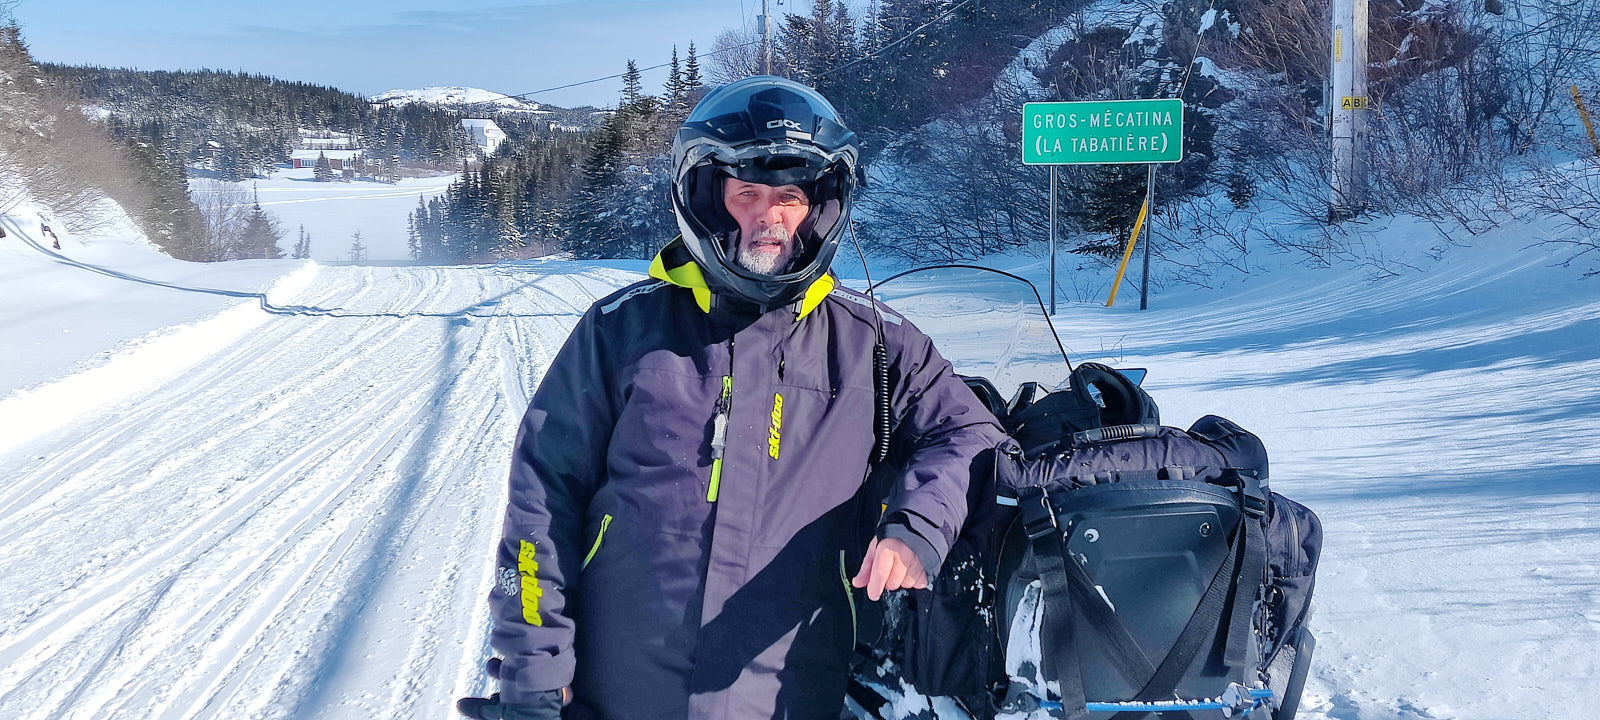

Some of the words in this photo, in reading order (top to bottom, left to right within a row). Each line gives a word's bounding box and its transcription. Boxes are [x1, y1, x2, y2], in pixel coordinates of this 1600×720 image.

[1033, 109, 1173, 129] GROS-MÉCATINA
[1035, 135, 1063, 156] (LA
[1071, 132, 1169, 154] TABATIÈRE)
